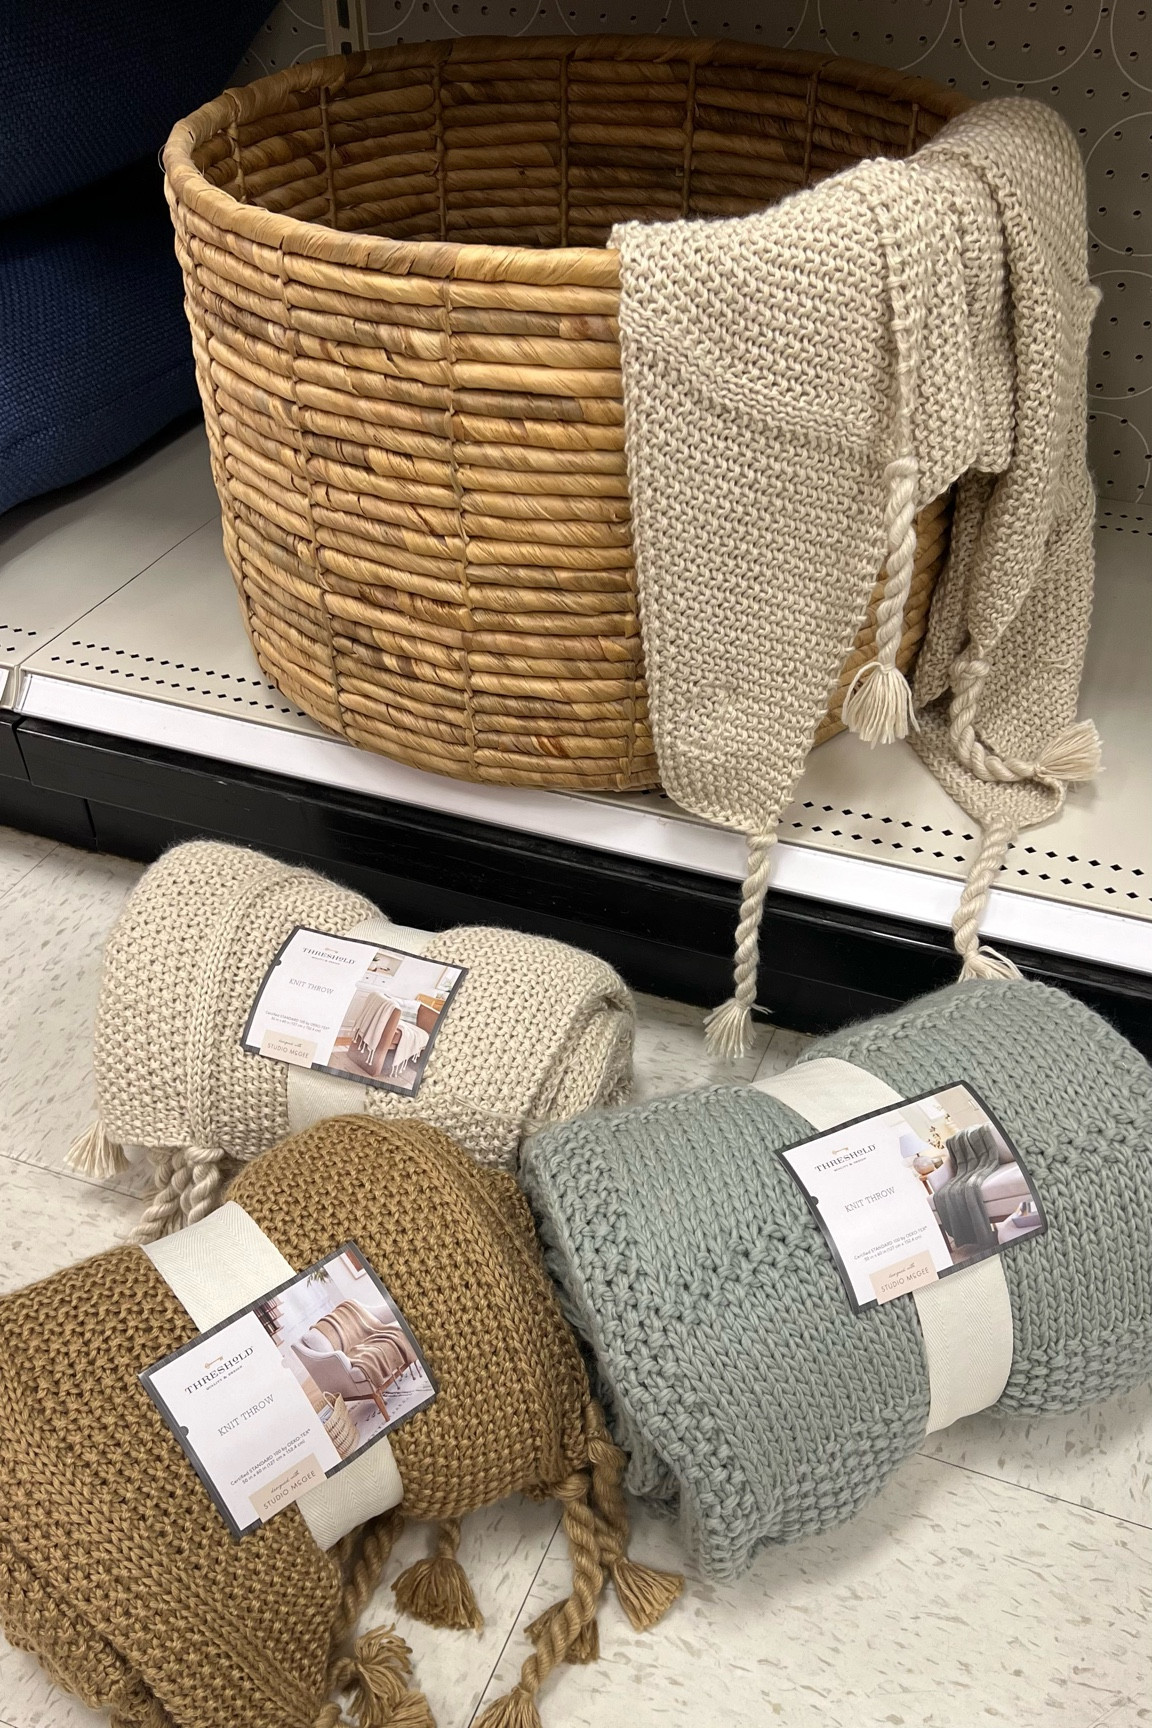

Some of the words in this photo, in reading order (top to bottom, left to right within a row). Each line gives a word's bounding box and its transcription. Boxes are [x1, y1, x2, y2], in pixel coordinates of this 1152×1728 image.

[303, 947, 356, 965] THRESHOLD
[289, 978, 307, 987] KNIT
[307, 982, 335, 994] THROW
[267, 1043, 288, 1053] STUDIO
[814, 1144, 877, 1172] THRESHOLD
[844, 1199, 865, 1213] KNIT
[864, 1186, 896, 1204] THROW
[870, 1240, 893, 1253] STANDARD
[881, 1277, 905, 1293] STUDIO
[184, 1346, 254, 1394] THRESHOLD
[217, 1417, 241, 1436] KNIT
[240, 1394, 275, 1420] THROW
[230, 1470, 249, 1486] Certified
[248, 1454, 273, 1473] STANDARD
[273, 1448, 281, 1457] 100
[263, 1488, 289, 1510] STUDIO
